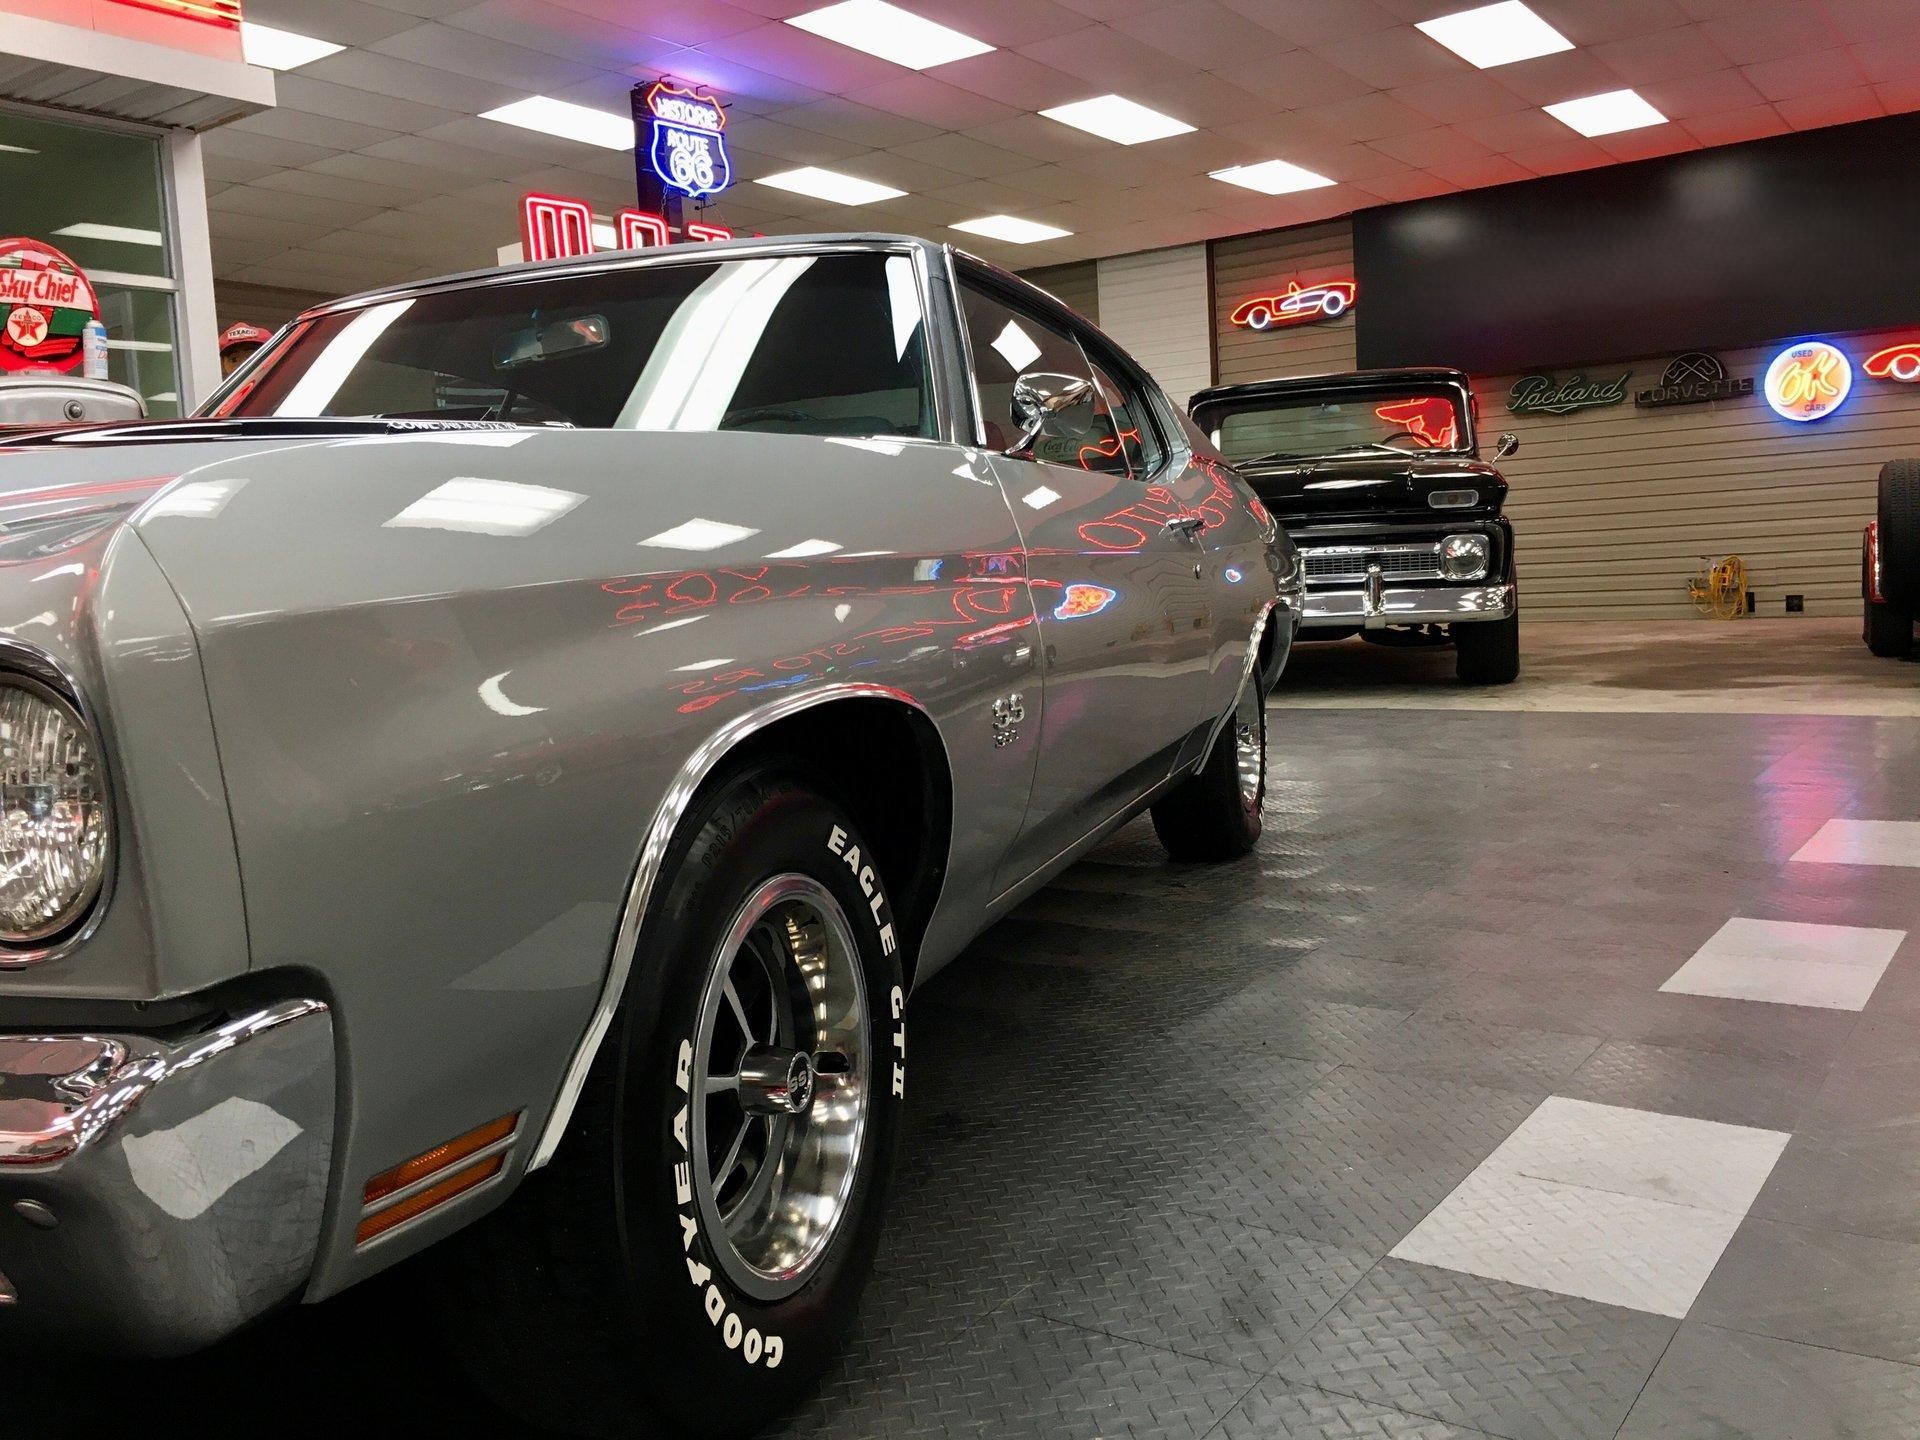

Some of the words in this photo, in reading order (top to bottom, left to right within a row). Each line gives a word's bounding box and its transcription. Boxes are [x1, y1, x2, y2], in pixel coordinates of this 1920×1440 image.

[656, 97, 718, 129] HISTORIC
[667, 130, 709, 153] ROUTE
[670, 147, 713, 188] 66
[0, 270, 32, 303] Sky
[34, 272, 80, 303] Chief
[1791, 349, 1813, 359] USED
[1505, 370, 1633, 412] Packard
[1638, 377, 1752, 404] CORVETTE
[1778, 351, 1840, 407] OK
[1804, 403, 1826, 412] CARS
[388, 421, 440, 430] COWL
[992, 693, 1025, 728] SS
[827, 824, 897, 957] EAGLE
[789, 1070, 807, 1093] SS
[673, 1038, 784, 1369] GOODYEAR
